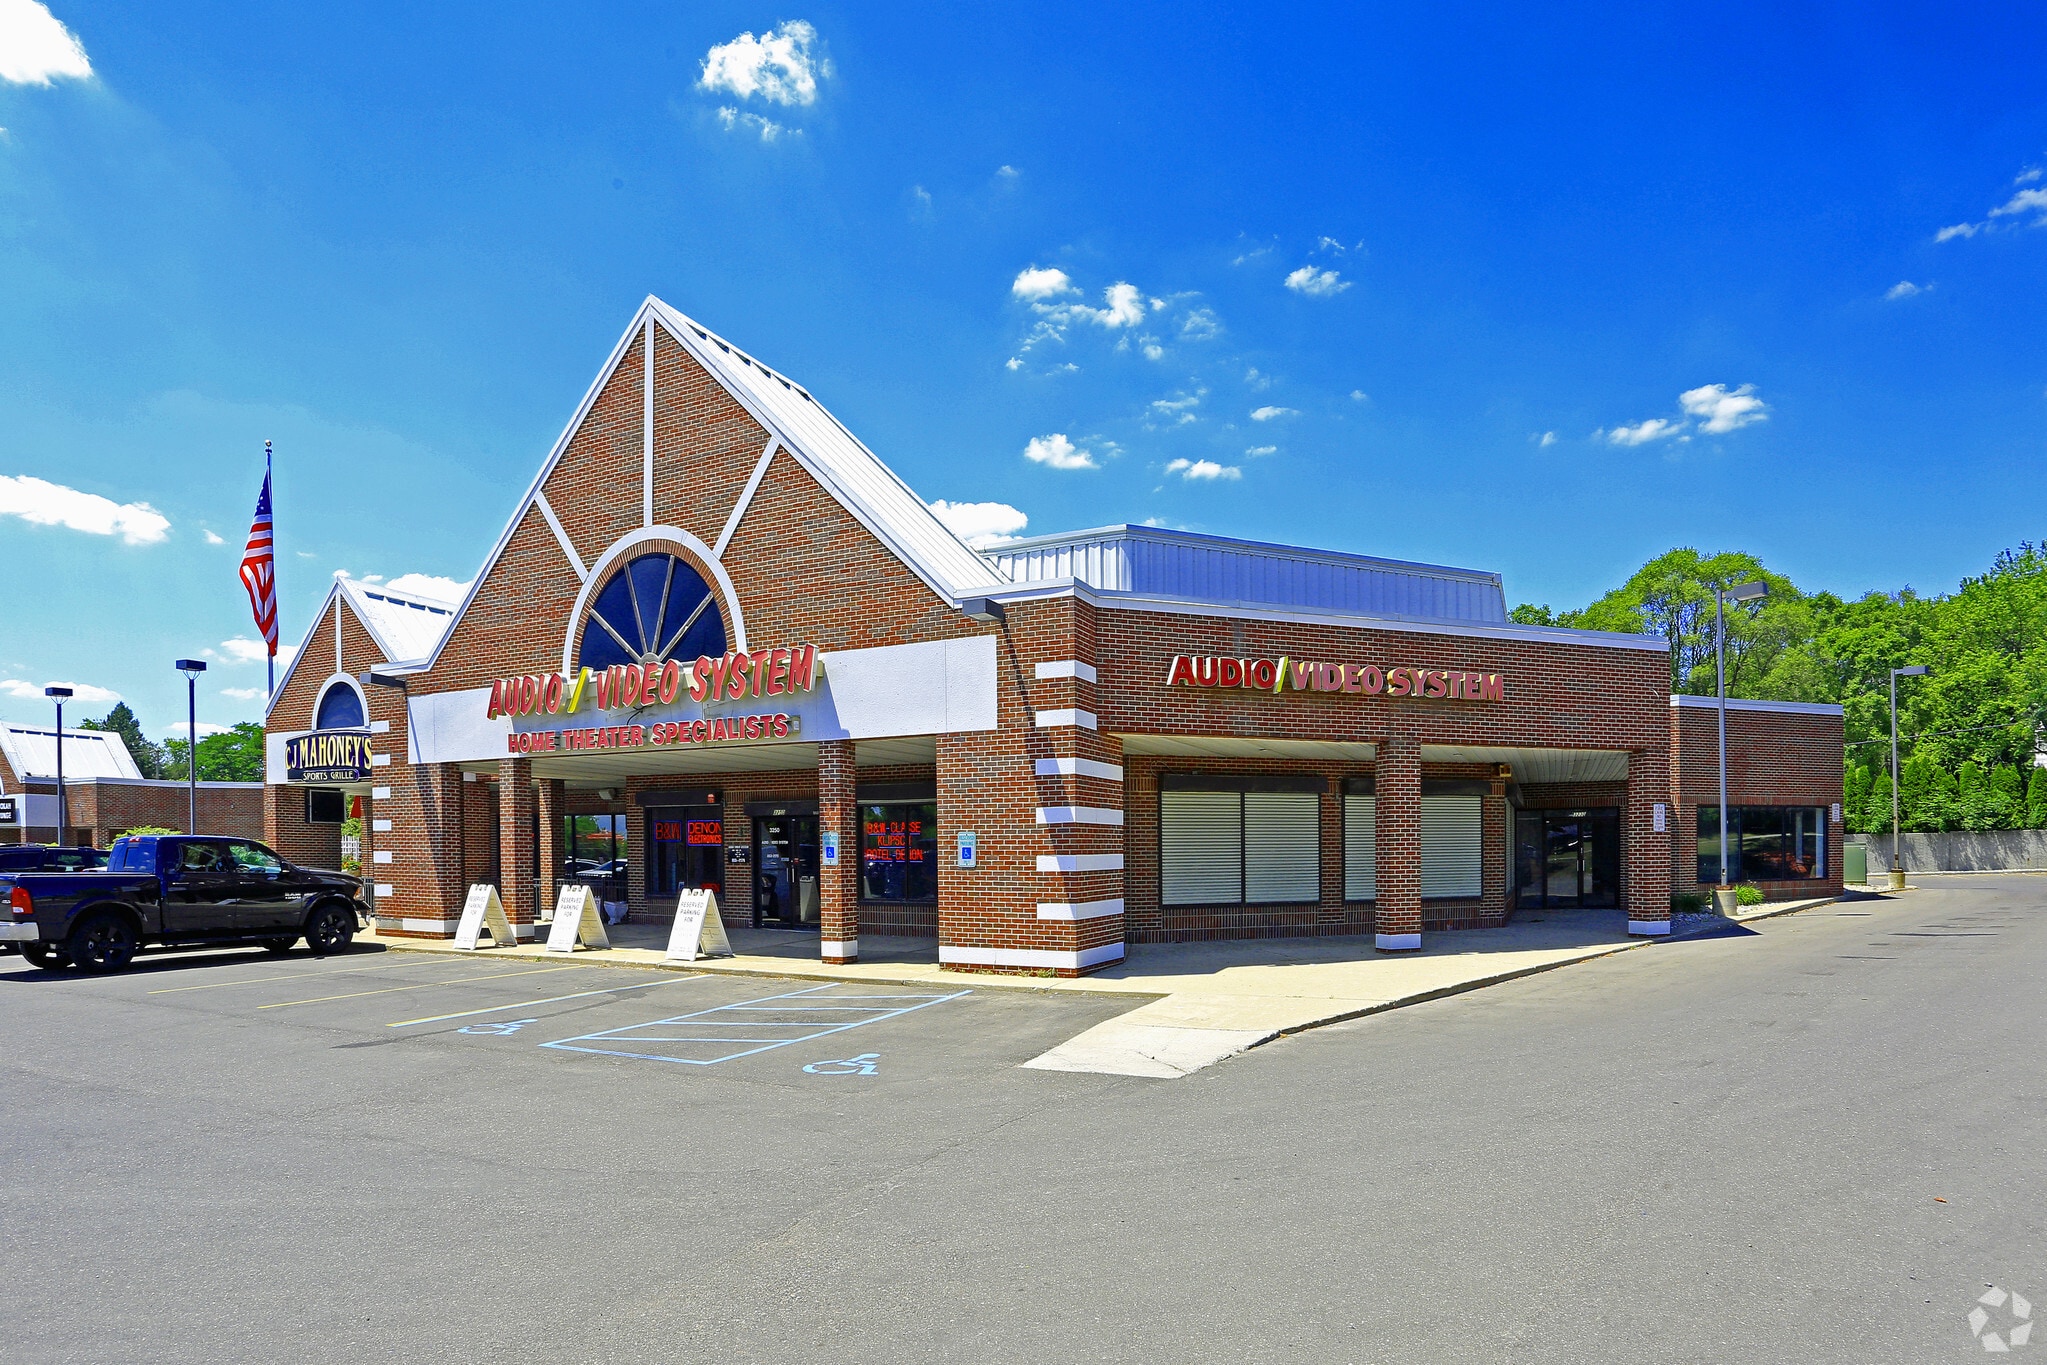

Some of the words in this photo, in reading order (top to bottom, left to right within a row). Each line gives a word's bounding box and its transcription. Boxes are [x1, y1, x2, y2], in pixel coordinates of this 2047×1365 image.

[487, 672, 564, 720] AUDIO
[596, 658, 682, 711] VIDEO
[689, 643, 818, 703] SYSTEM
[1387, 667, 1503, 700] SYSTEM
[508, 731, 557, 754] HOME
[562, 724, 646, 751] THEATER
[651, 712, 790, 746] SPECIALISTS
[285, 744, 298, 770] CJ
[299, 734, 373, 770] MAHONEY'S
[303, 771, 328, 781] SPORTS
[330, 770, 354, 780] GRILLE
[655, 822, 681, 840] B&W
[688, 834, 722, 844] ELECTRONICS
[680, 901, 705, 909] RESERVED
[680, 908, 701, 916] PARKING
